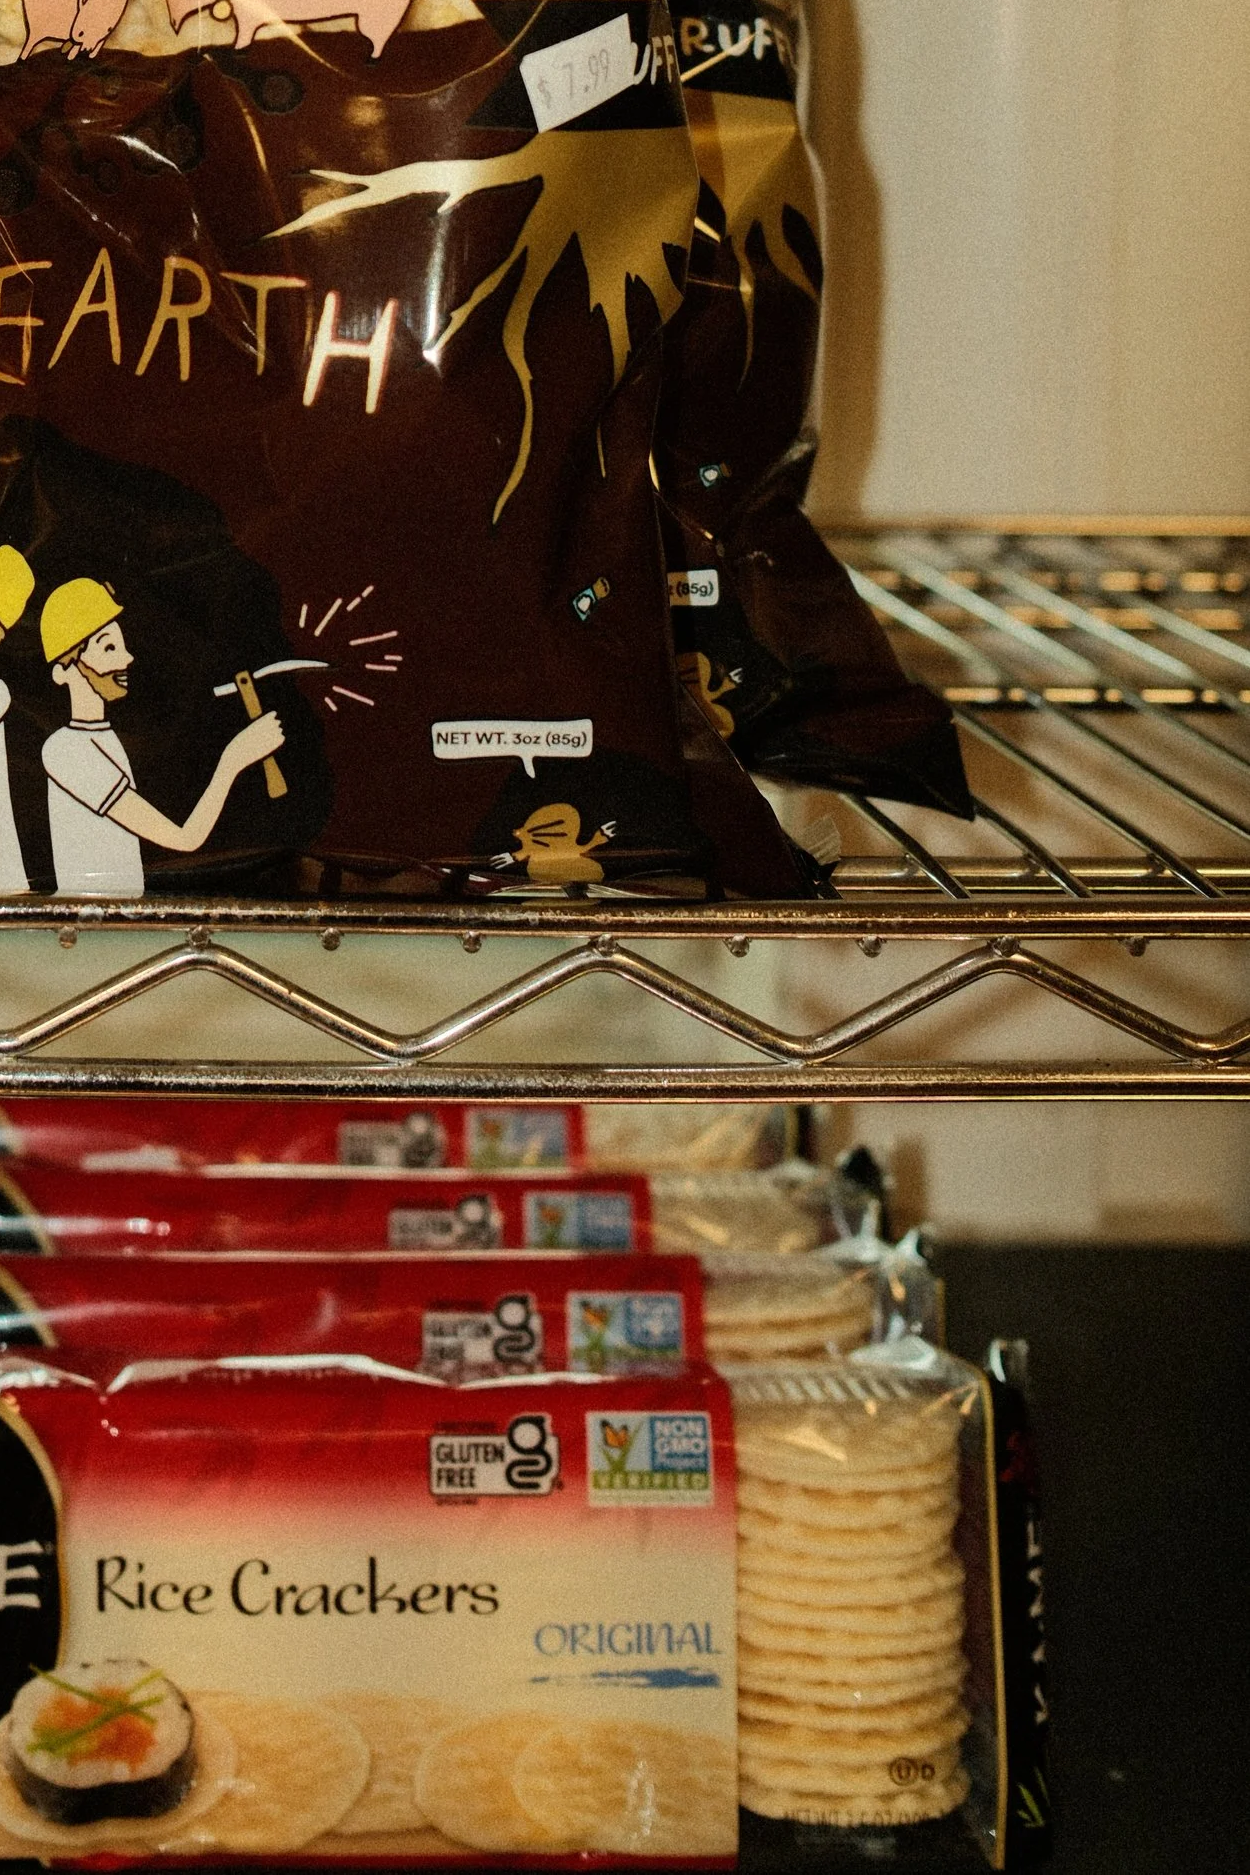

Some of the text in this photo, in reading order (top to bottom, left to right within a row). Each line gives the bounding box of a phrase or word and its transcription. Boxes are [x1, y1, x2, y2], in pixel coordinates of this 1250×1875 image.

[557, 47, 611, 100] 7.99
[435, 730, 588, 749] NET WT. 3oz (85g)
[653, 1418, 705, 1435] NON
[435, 1441, 505, 1464] GLUTEN
[435, 1466, 478, 1490] FREE
[95, 1556, 500, 1617] Rice Crackers
[533, 1621, 724, 1659] ORIGINAL
